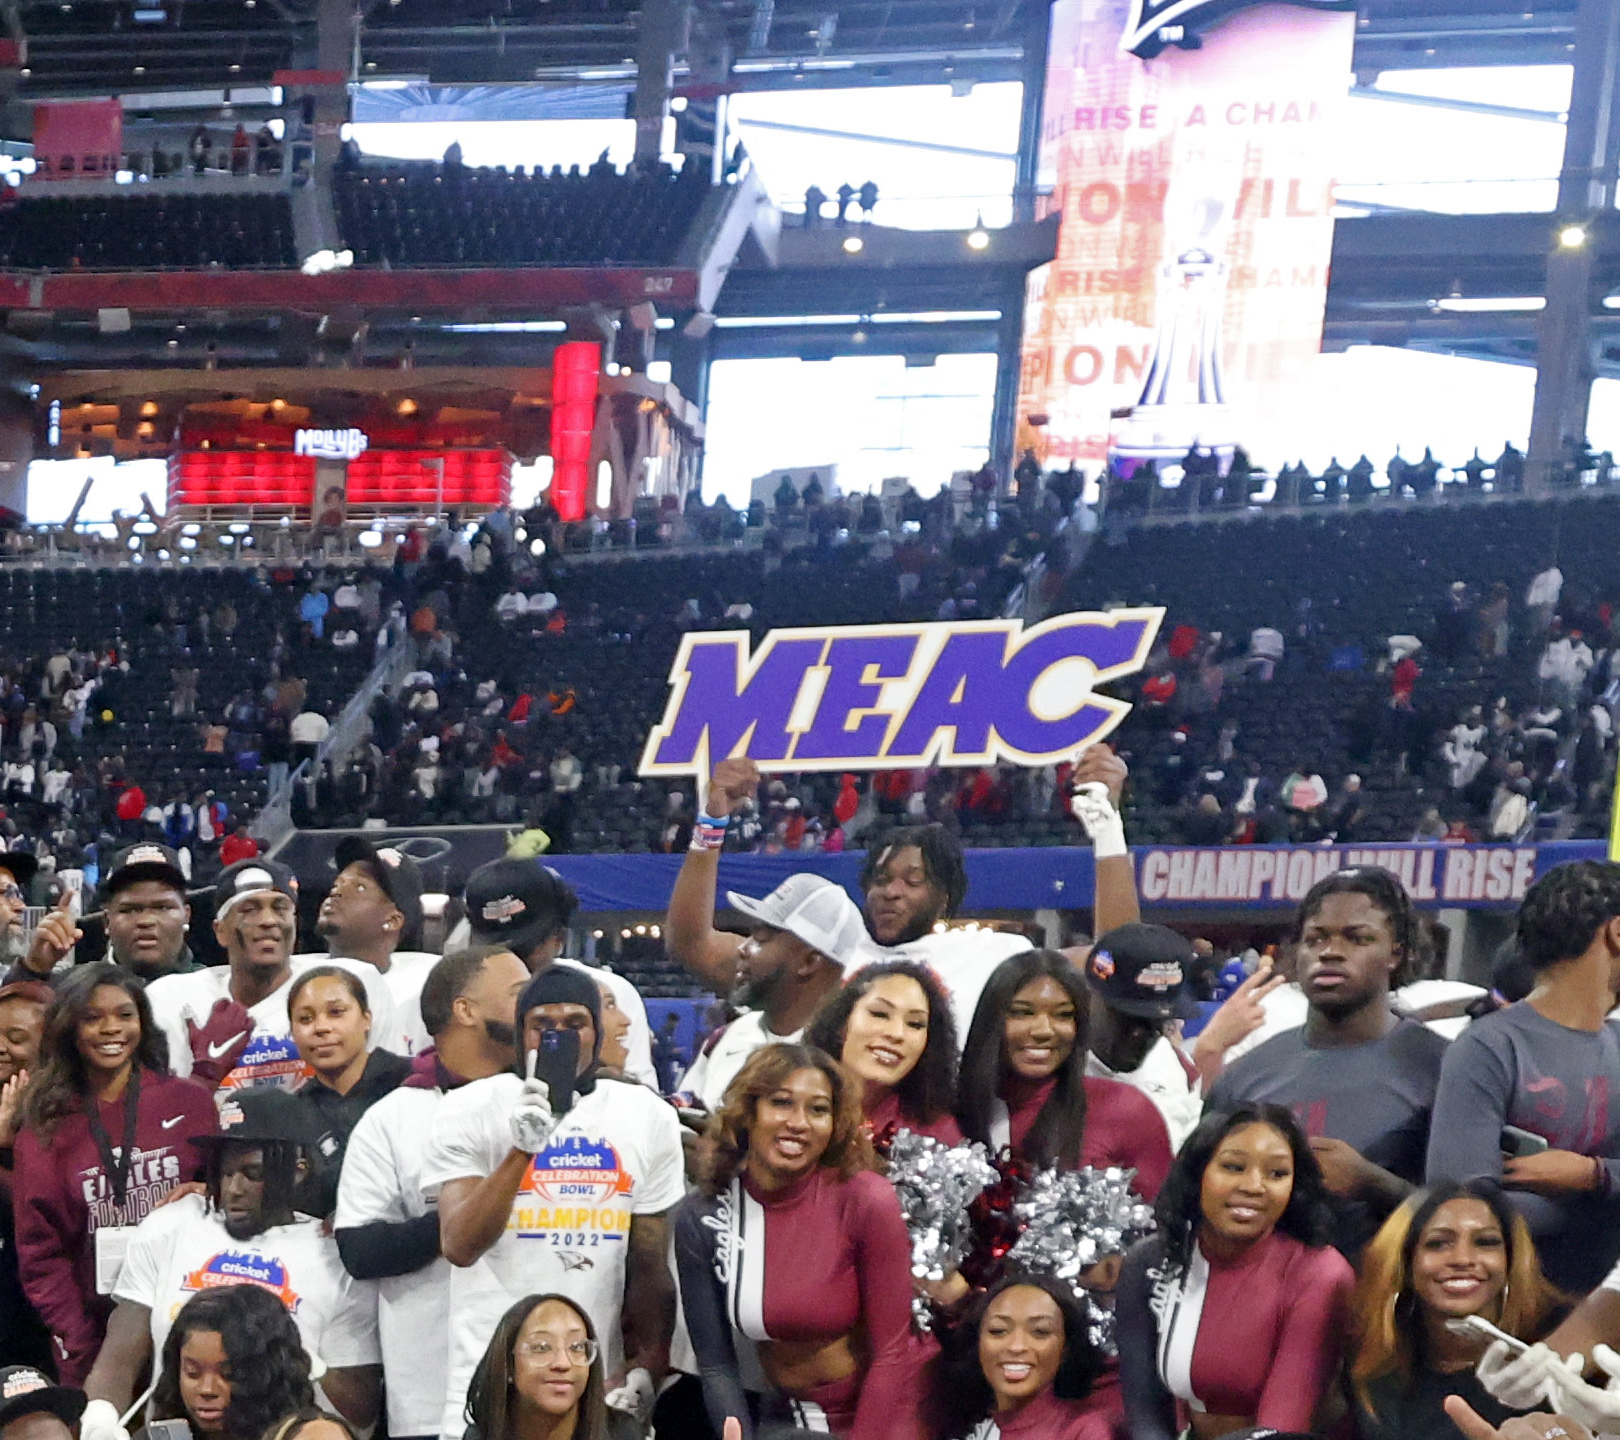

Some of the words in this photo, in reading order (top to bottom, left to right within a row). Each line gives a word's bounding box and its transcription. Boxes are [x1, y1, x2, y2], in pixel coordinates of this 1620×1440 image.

[1074, 104, 1159, 132] RISE
[655, 615, 1160, 767] MEAC
[1142, 851, 1341, 901] CHAMPION
[1444, 849, 1537, 900] RISE
[242, 1047, 290, 1064] cricket
[548, 1153, 602, 1167] cricket
[532, 1170, 626, 1185] CELEBRATION
[558, 1182, 596, 1195] BOWL
[551, 1233, 600, 1247] 2022
[218, 1260, 271, 1281] cricket
